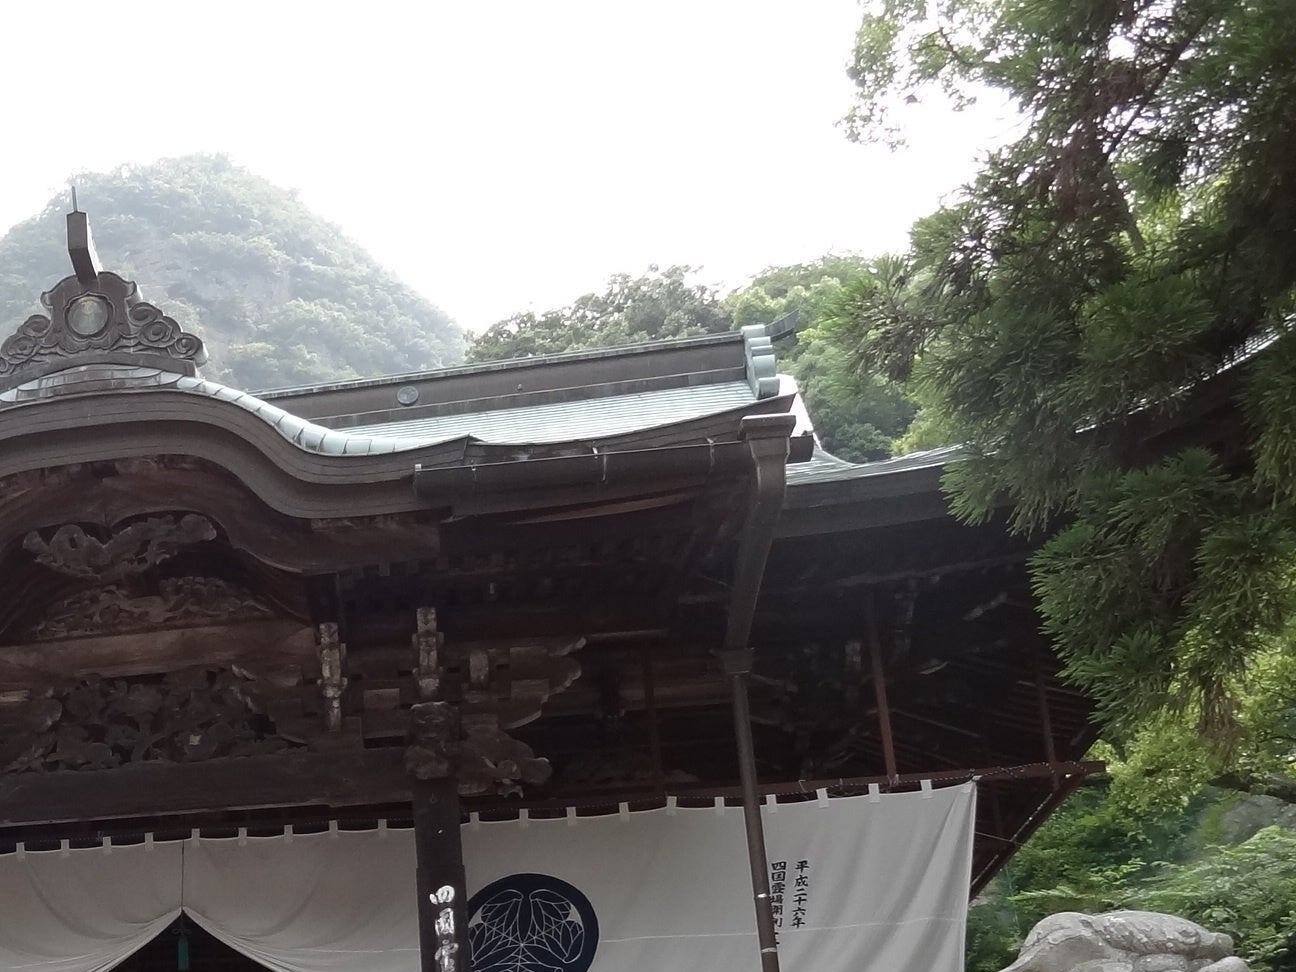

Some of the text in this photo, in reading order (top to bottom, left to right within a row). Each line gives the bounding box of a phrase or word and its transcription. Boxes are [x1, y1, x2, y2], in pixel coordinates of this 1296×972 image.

[791, 860, 809, 928] 平成二十六年
